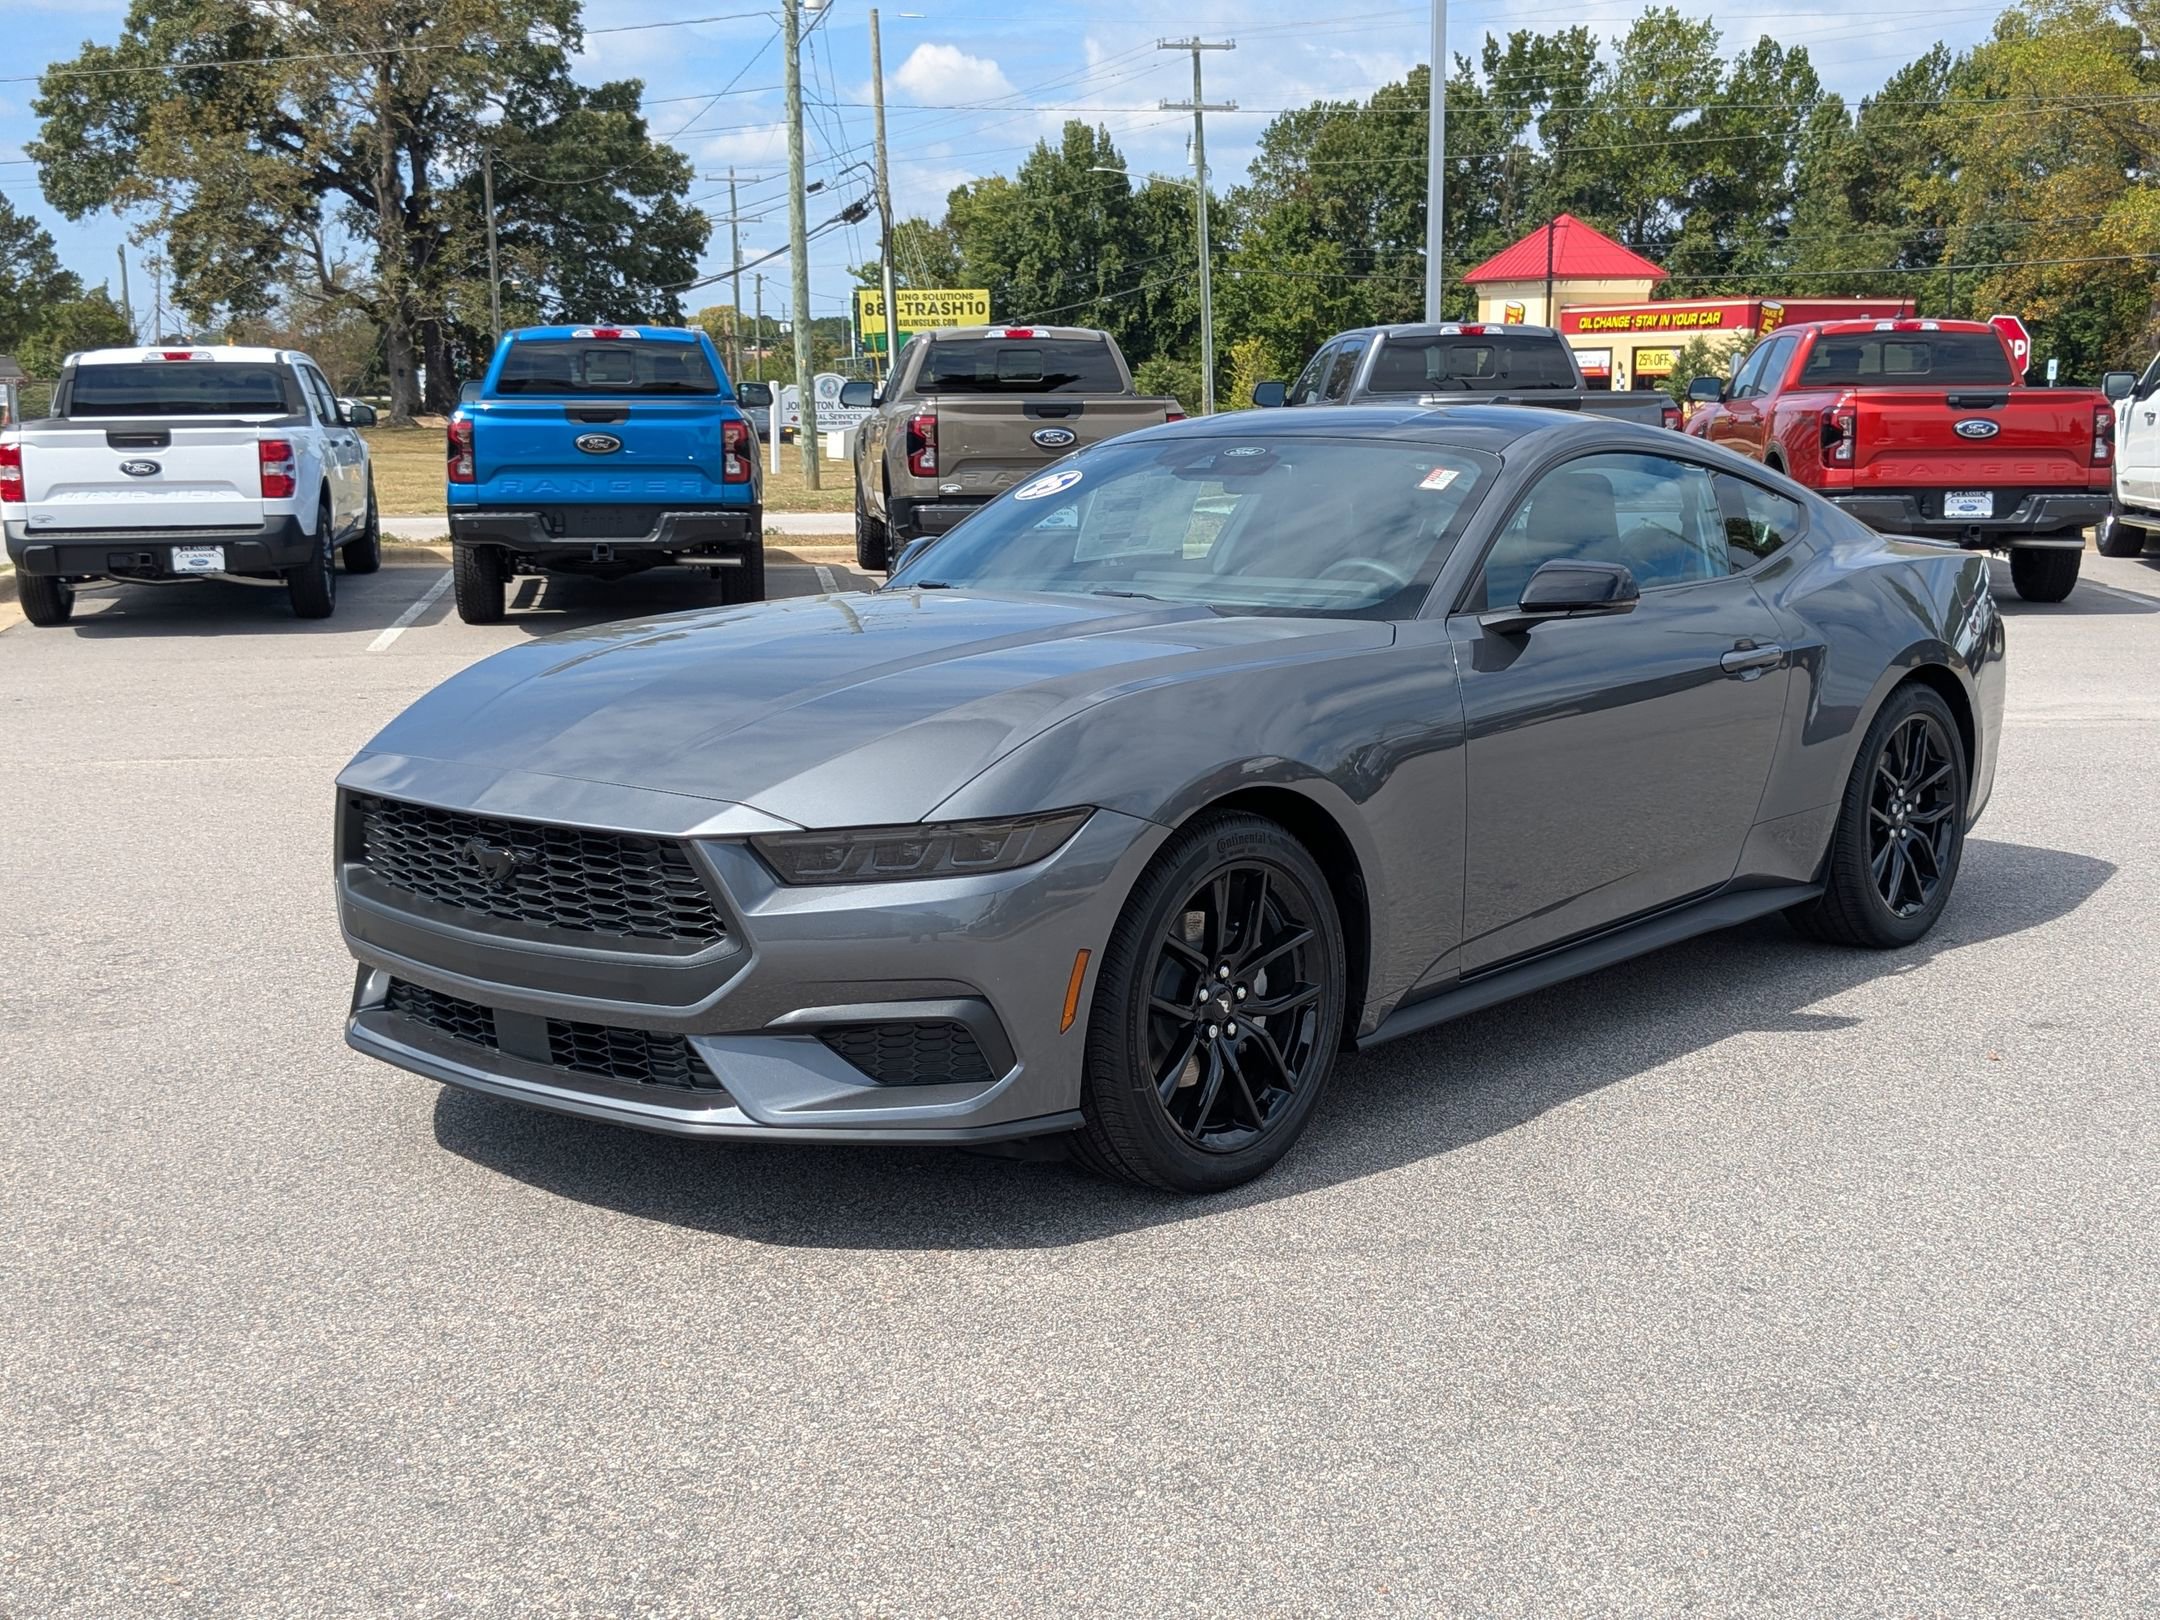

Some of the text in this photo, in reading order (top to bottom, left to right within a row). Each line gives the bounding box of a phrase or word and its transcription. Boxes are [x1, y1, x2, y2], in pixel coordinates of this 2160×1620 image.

[877, 292, 974, 301] HLING SOLUTIONS
[865, 302, 985, 316] 88-TRASH10
[1579, 312, 1721, 329] OIL CHANGE STAY IN YOUR CAR
[786, 402, 834, 410] JOTON
[1877, 463, 2071, 477] RANGER
[500, 480, 703, 493] RANGER
[1216, 832, 1266, 853] Continental
